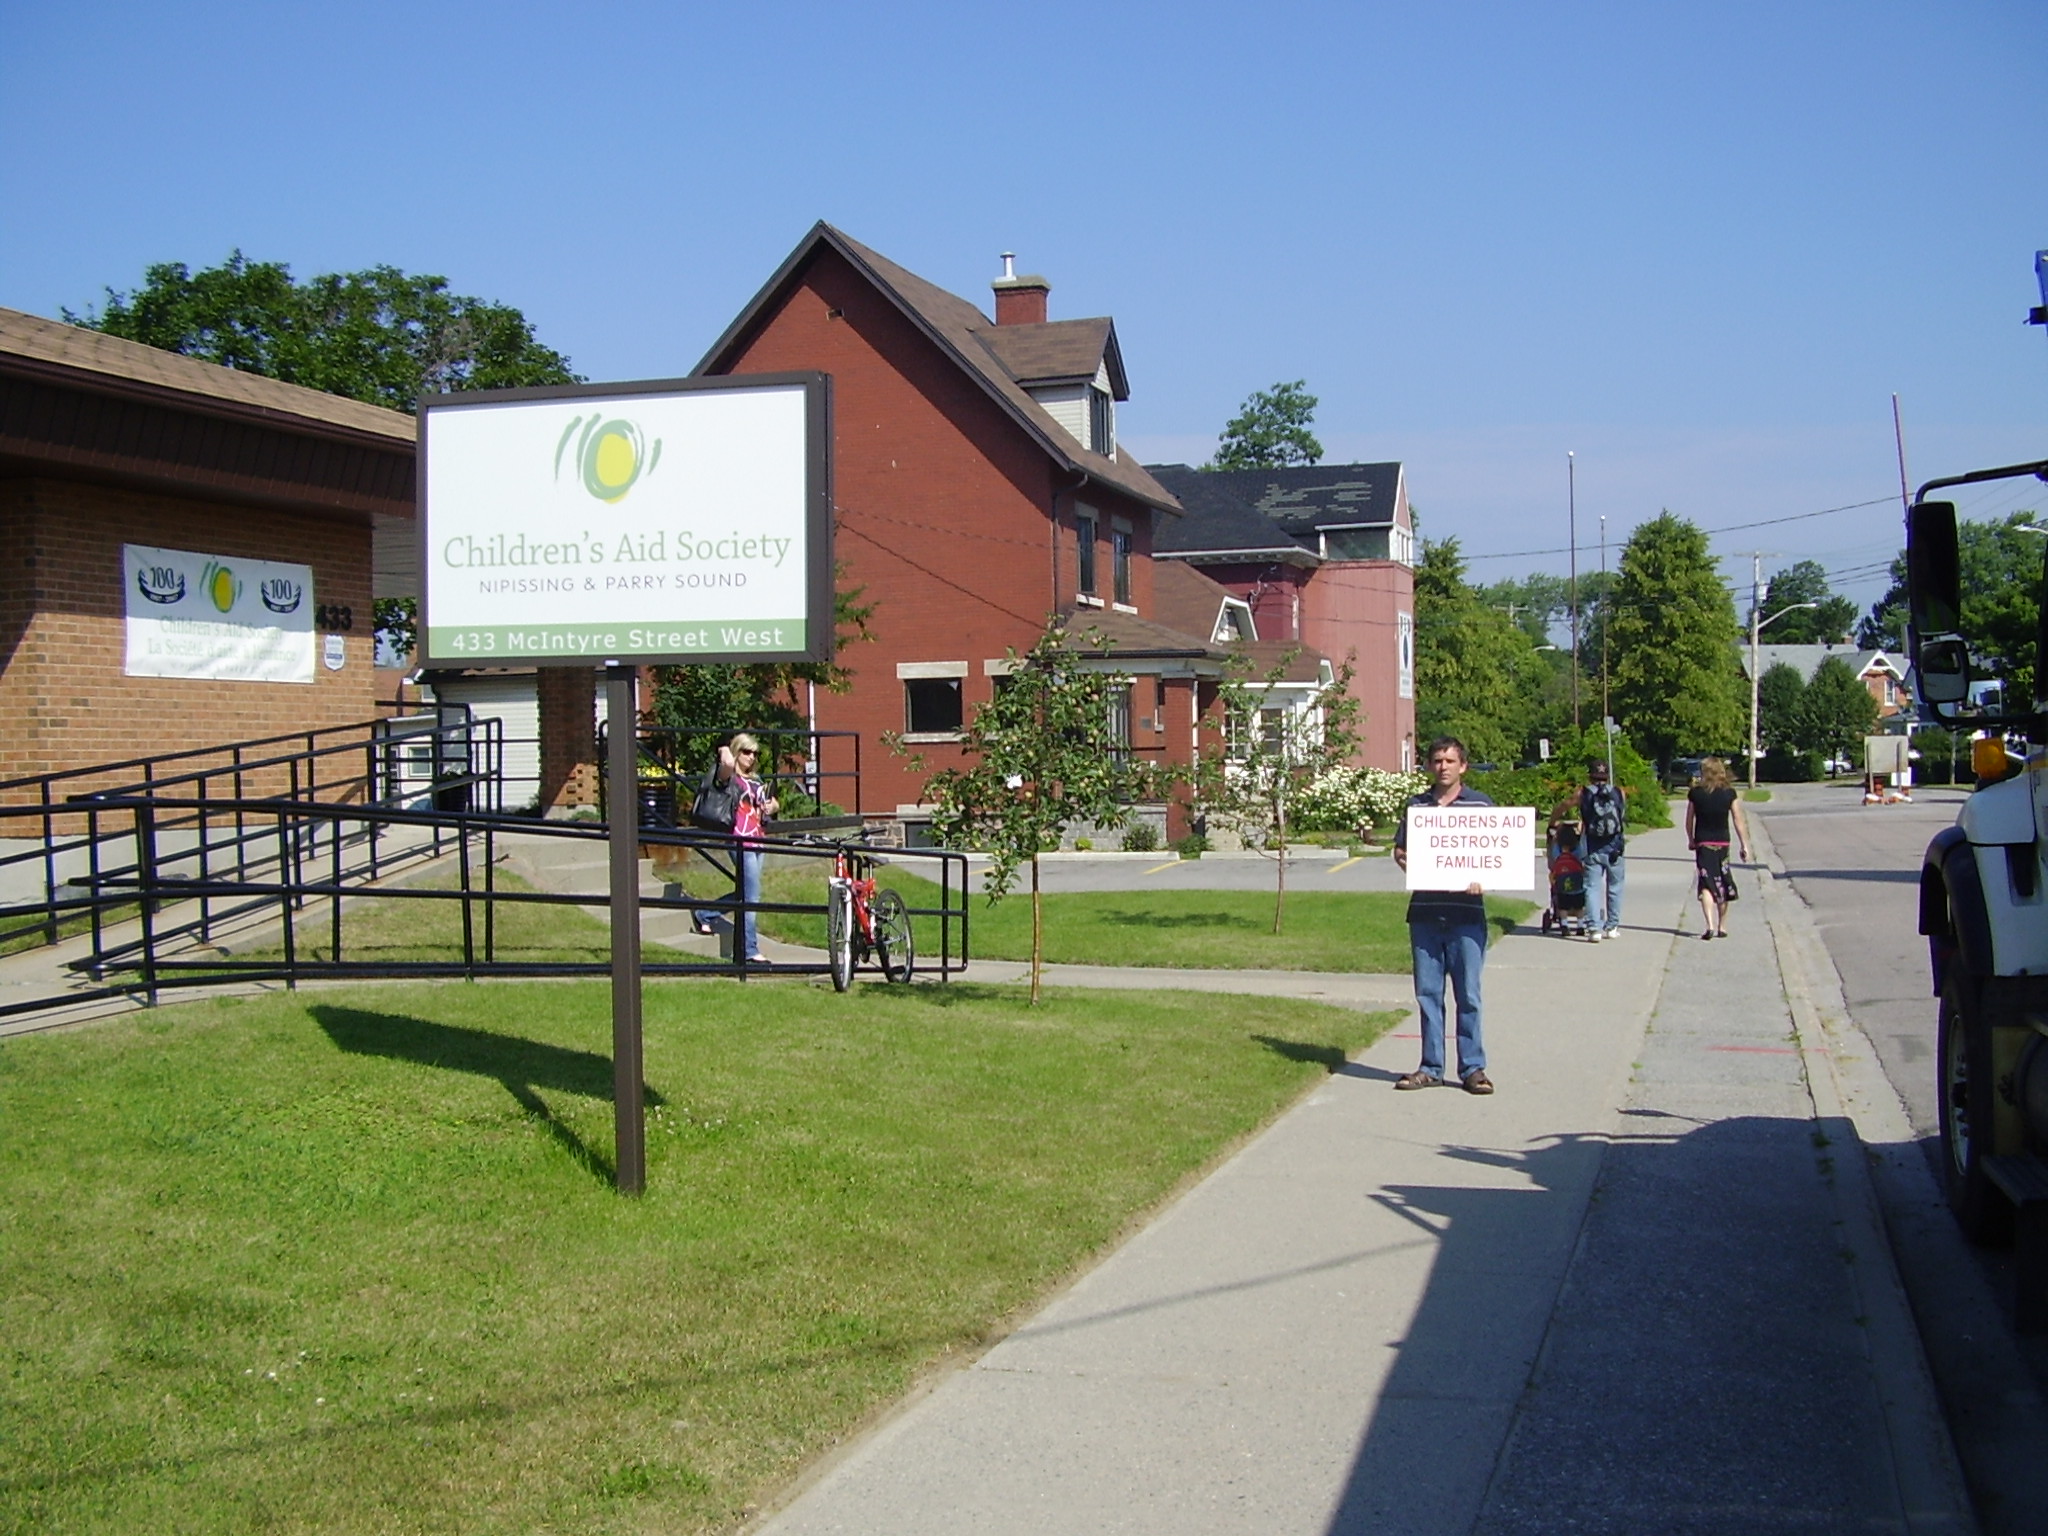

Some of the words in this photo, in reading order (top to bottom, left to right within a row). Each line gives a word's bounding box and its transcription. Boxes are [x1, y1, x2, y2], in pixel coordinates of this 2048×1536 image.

[444, 531, 604, 568] Children's
[614, 531, 667, 562] Aid
[677, 530, 791, 568] Society
[150, 567, 175, 589] 100
[270, 578, 292, 600] 100
[479, 577, 575, 593] NIPISSING
[584, 576, 596, 591] &
[606, 574, 665, 590] PARRY
[675, 572, 747, 589] SOUND
[316, 605, 352, 630] 433
[452, 632, 496, 651] 433
[508, 630, 616, 653] McIntyre
[629, 629, 708, 649] Street
[721, 627, 783, 646] West
[1414, 815, 1498, 828] CHILDRENS
[1502, 815, 1526, 828] AID
[1430, 835, 1509, 848] DESTROYS
[1436, 855, 1503, 869] FAMILIES
